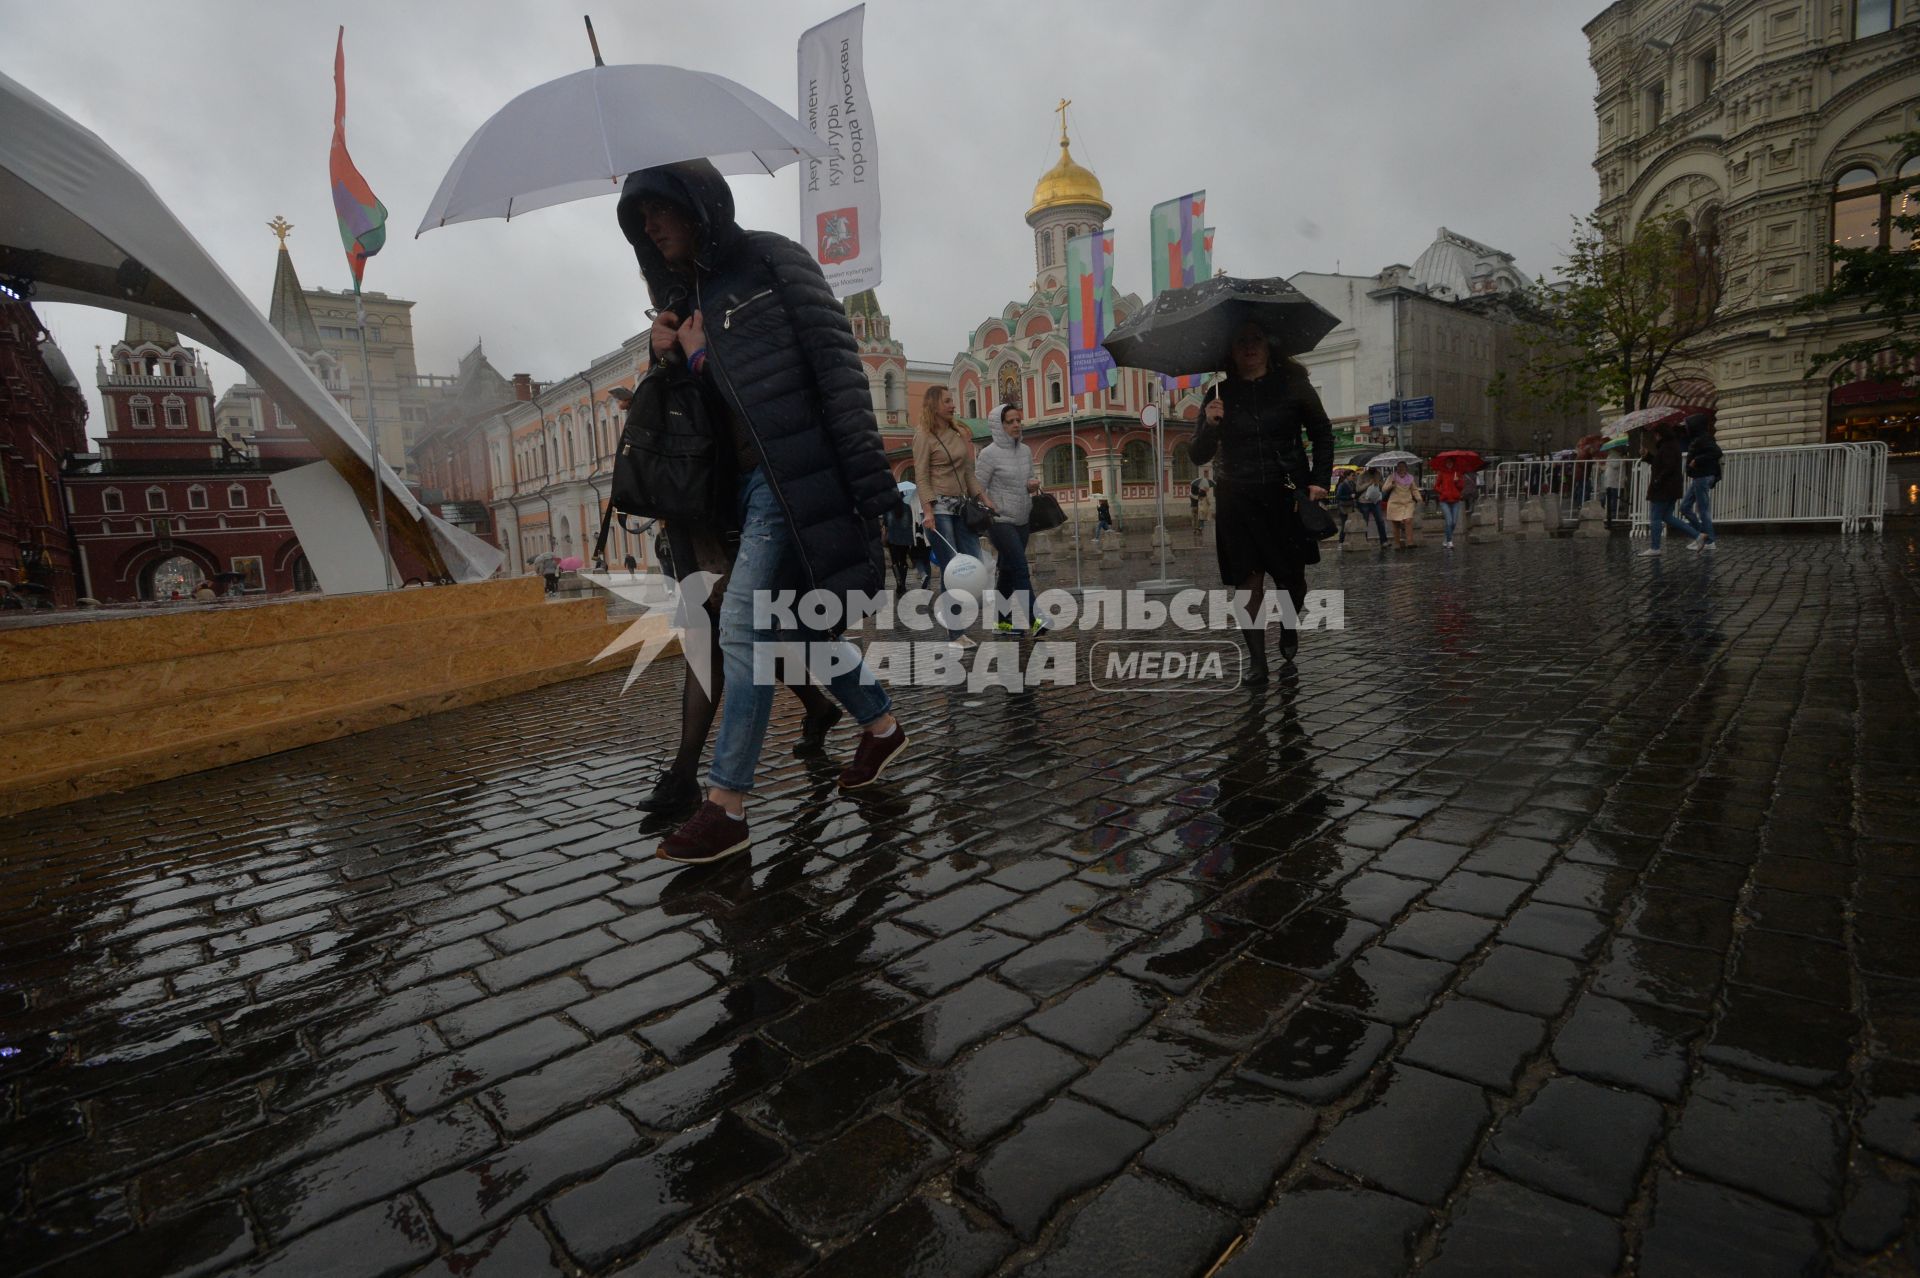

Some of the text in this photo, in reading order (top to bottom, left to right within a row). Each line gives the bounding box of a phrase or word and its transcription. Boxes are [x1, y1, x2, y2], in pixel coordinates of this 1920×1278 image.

[808, 79, 820, 193] Депамент
[841, 38, 867, 185] города Москвы
